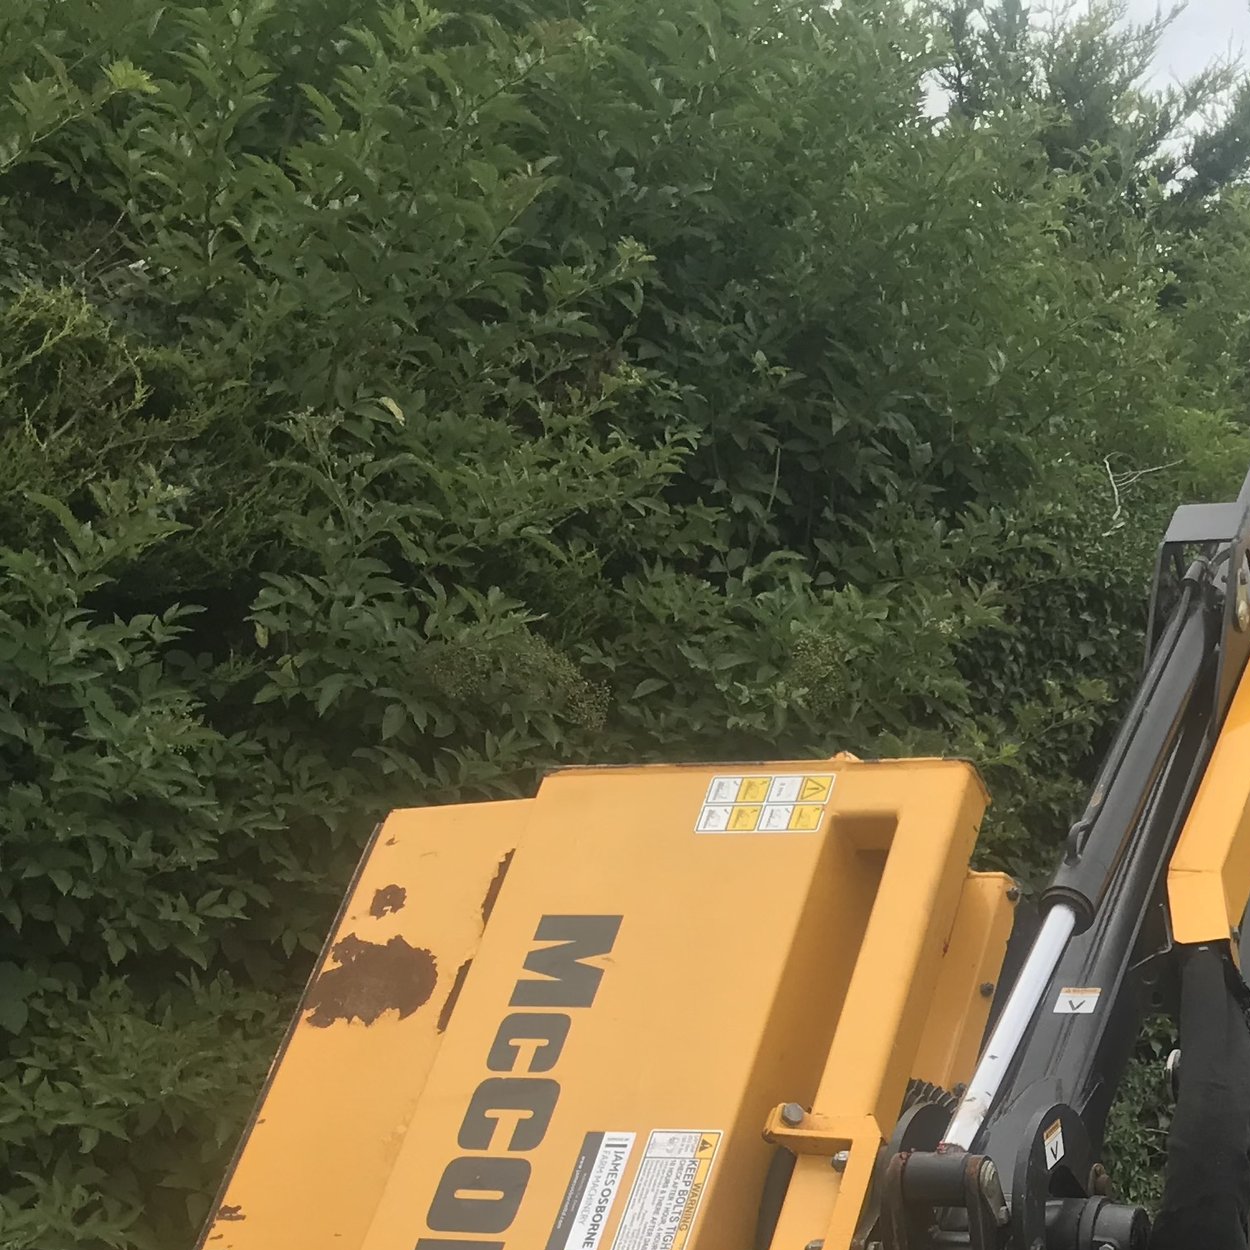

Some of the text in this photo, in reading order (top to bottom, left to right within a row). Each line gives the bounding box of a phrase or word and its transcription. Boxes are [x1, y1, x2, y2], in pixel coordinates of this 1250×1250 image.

[595, 1149, 611, 1173] FARM
[601, 1150, 625, 1186] JAMES
[683, 1159, 698, 1187] KEEP
[576, 1175, 602, 1225] MACHINERY
[580, 1187, 612, 1249] OSBORNE
[670, 1189, 689, 1223] BOLTS
[680, 1182, 701, 1232] WARNING
